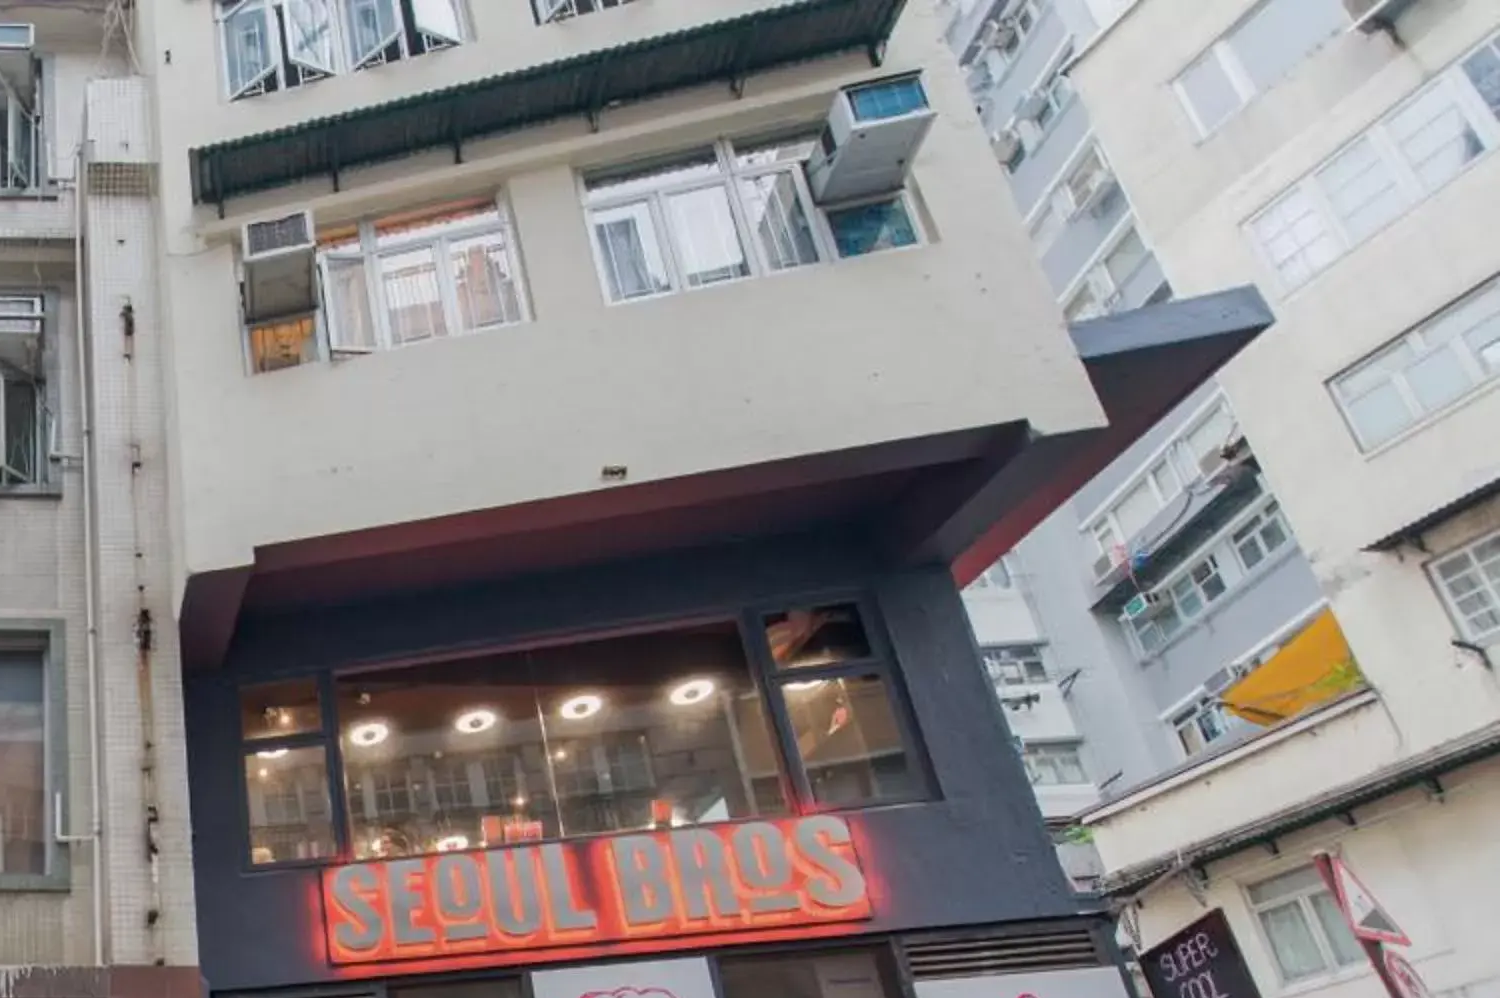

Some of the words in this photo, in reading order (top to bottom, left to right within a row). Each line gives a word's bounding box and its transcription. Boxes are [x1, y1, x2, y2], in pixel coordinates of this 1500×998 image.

[331, 842, 597, 951] SEOUL
[611, 814, 867, 925] BROS
[1160, 932, 1218, 982] SUPER
